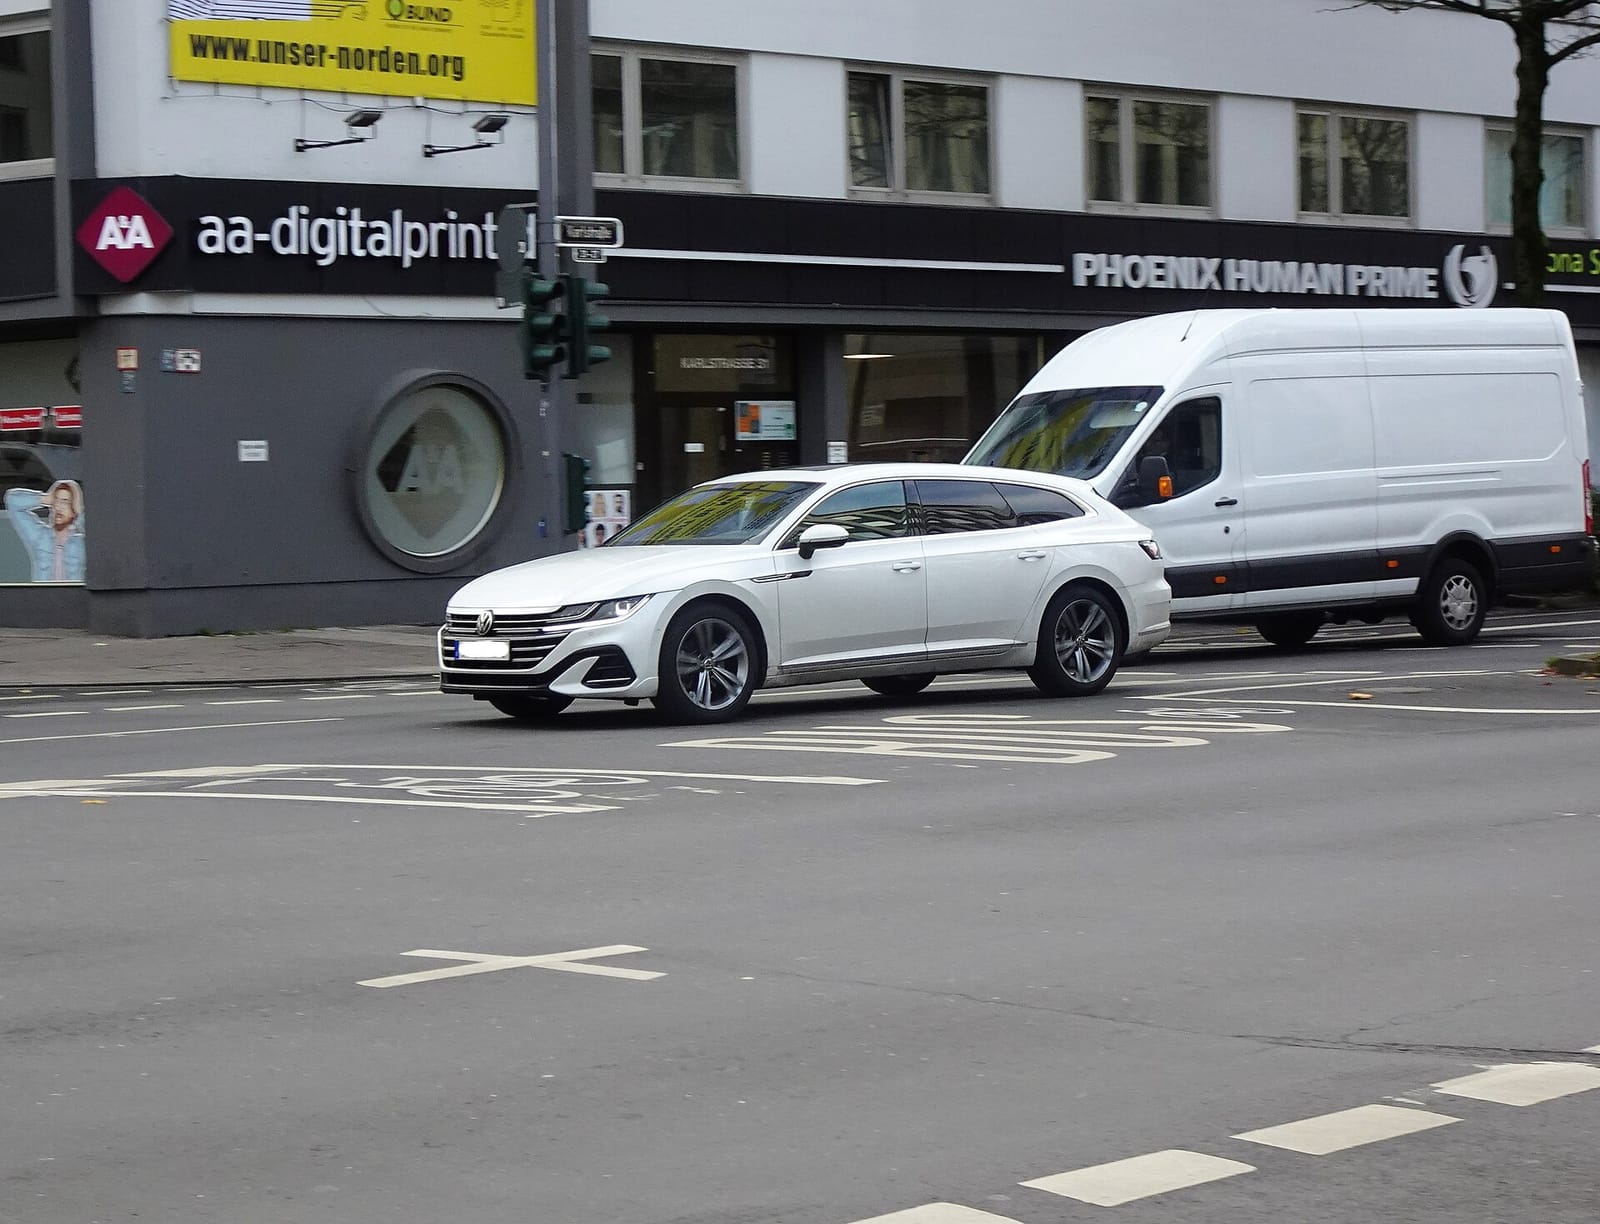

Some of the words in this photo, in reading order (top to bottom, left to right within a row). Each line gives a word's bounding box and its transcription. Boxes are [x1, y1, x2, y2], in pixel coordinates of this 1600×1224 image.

[407, 4, 453, 23] BUND
[189, 34, 465, 81] www.unser-norden.org
[1071, 252, 1222, 291] PHOENIX
[1223, 258, 1344, 295] HUMAN
[1345, 264, 1439, 299] PRIME
